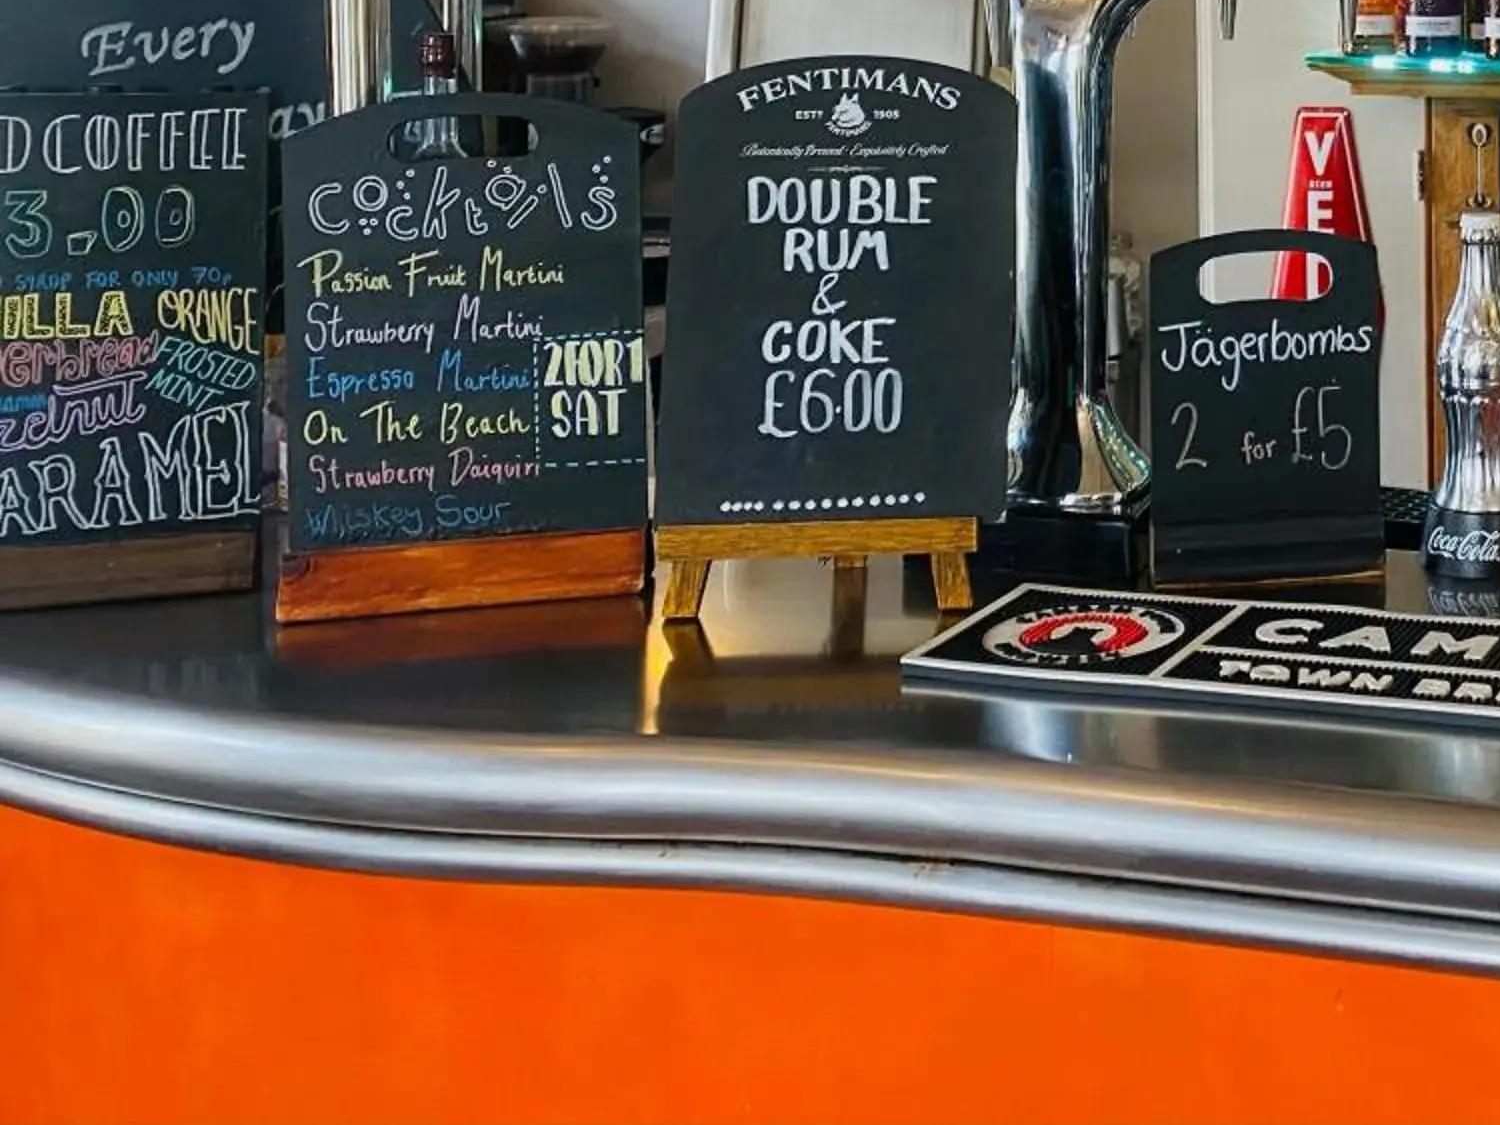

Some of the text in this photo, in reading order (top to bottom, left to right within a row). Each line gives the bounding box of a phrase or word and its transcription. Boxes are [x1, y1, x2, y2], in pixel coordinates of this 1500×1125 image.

[81, 18, 256, 76] Every
[736, 66, 962, 112] FENTIMANS
[42, 108, 248, 174] COFFEE
[746, 175, 938, 225] DOUBLE
[297, 245, 565, 298] Passion Fruit Martini
[783, 228, 890, 273] RUM
[86, 269, 121, 289] FOR
[131, 269, 179, 288] ONLY
[811, 272, 848, 316] &
[157, 287, 261, 355] ORANGE
[304, 293, 544, 353] Strawberry Martini
[761, 318, 897, 364] COKE
[156, 335, 257, 391] FROSTED
[305, 356, 414, 403] Espresso
[437, 348, 532, 393] Martini
[1157, 318, 1374, 393] Jägerbombs
[144, 368, 226, 413] MINT
[550, 388, 628, 439] SAT
[303, 399, 531, 446] On The Beach
[1170, 383, 1353, 471] 2 for £5
[309, 446, 541, 494] Strawberry Daiquiri
[305, 494, 512, 542] Whiskey Sour
[1219, 659, 1394, 694] TOWN
